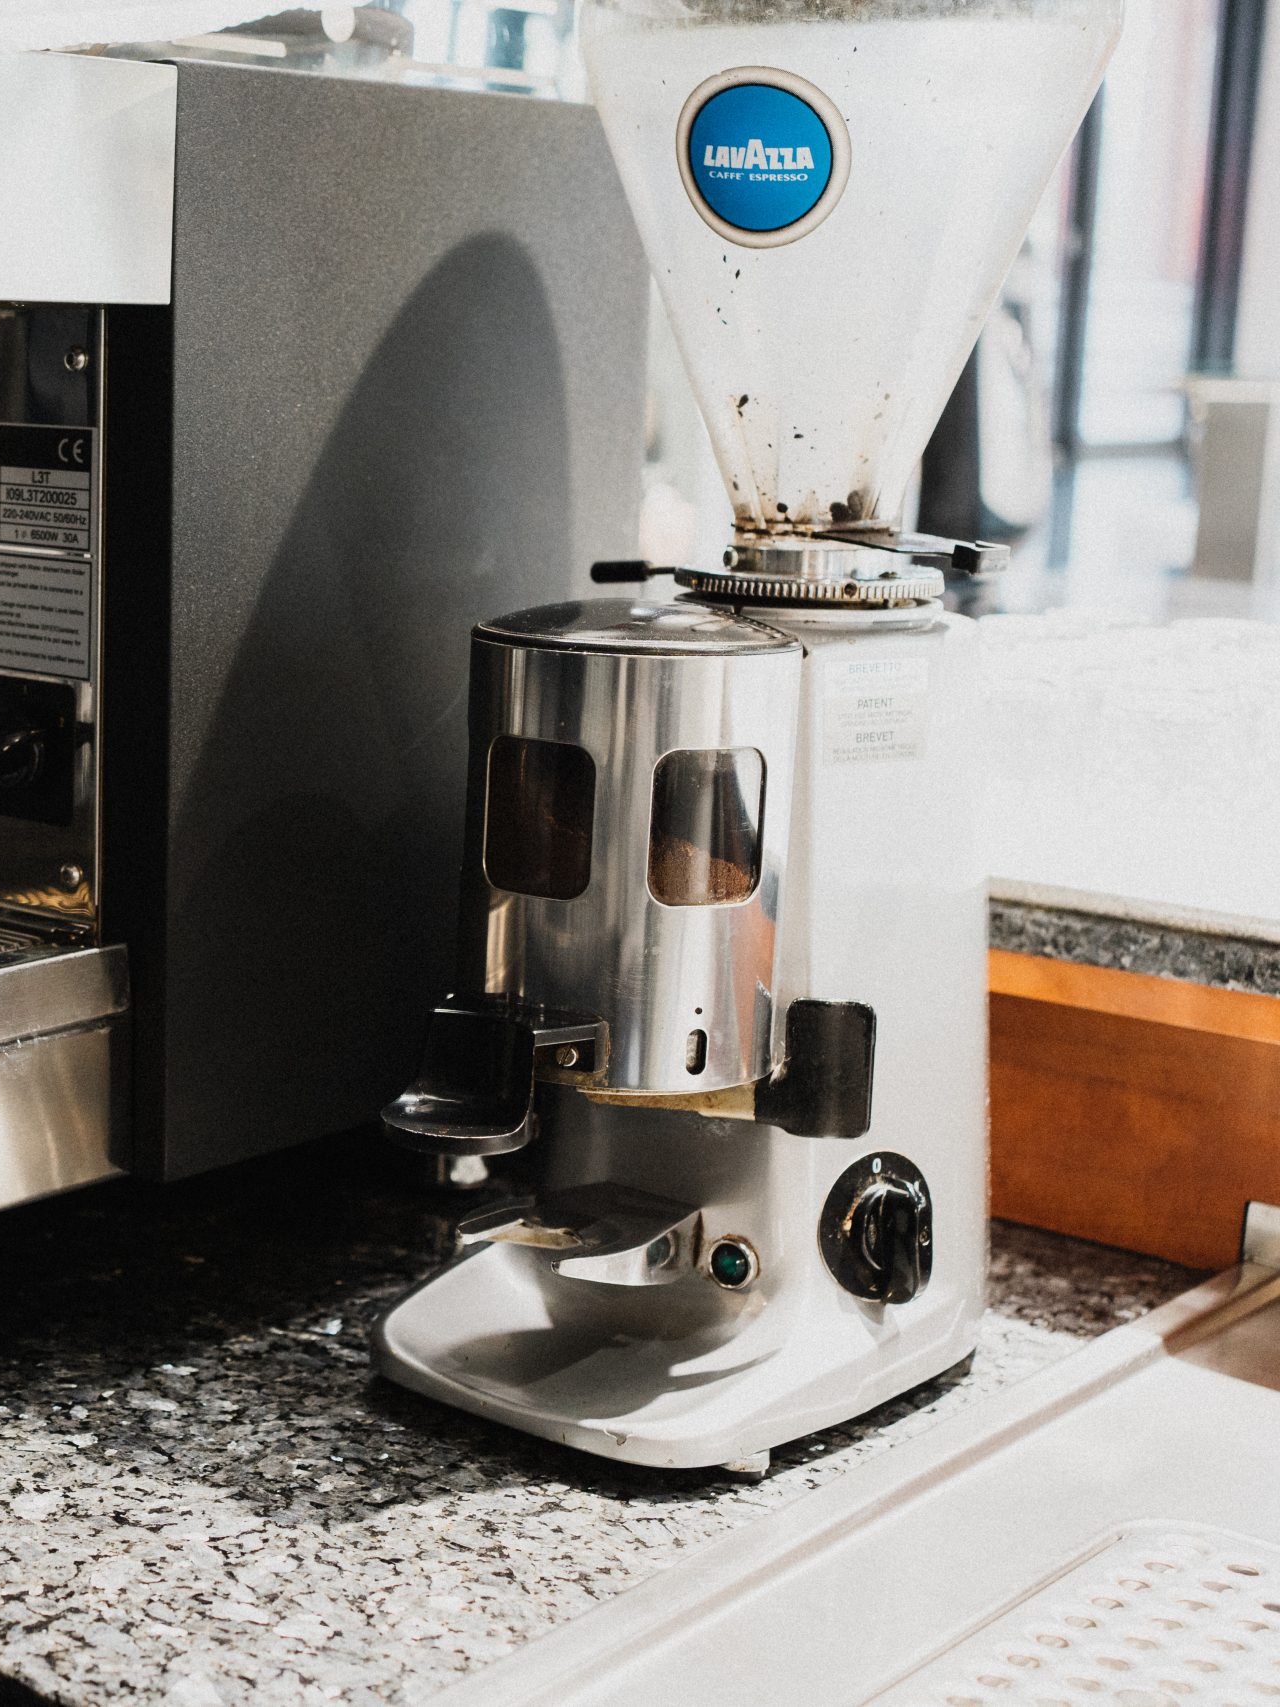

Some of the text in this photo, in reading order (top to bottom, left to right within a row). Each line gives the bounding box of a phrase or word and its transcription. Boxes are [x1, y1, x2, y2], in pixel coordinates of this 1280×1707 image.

[703, 138, 815, 170] LAVAZZA
[749, 172, 808, 182] ESPRESSO
[58, 438, 84, 463] CE
[31, 470, 51, 485] L3T
[30, 529, 59, 541] 6500W
[857, 697, 895, 710] PATENT
[856, 731, 894, 743] BREVET
